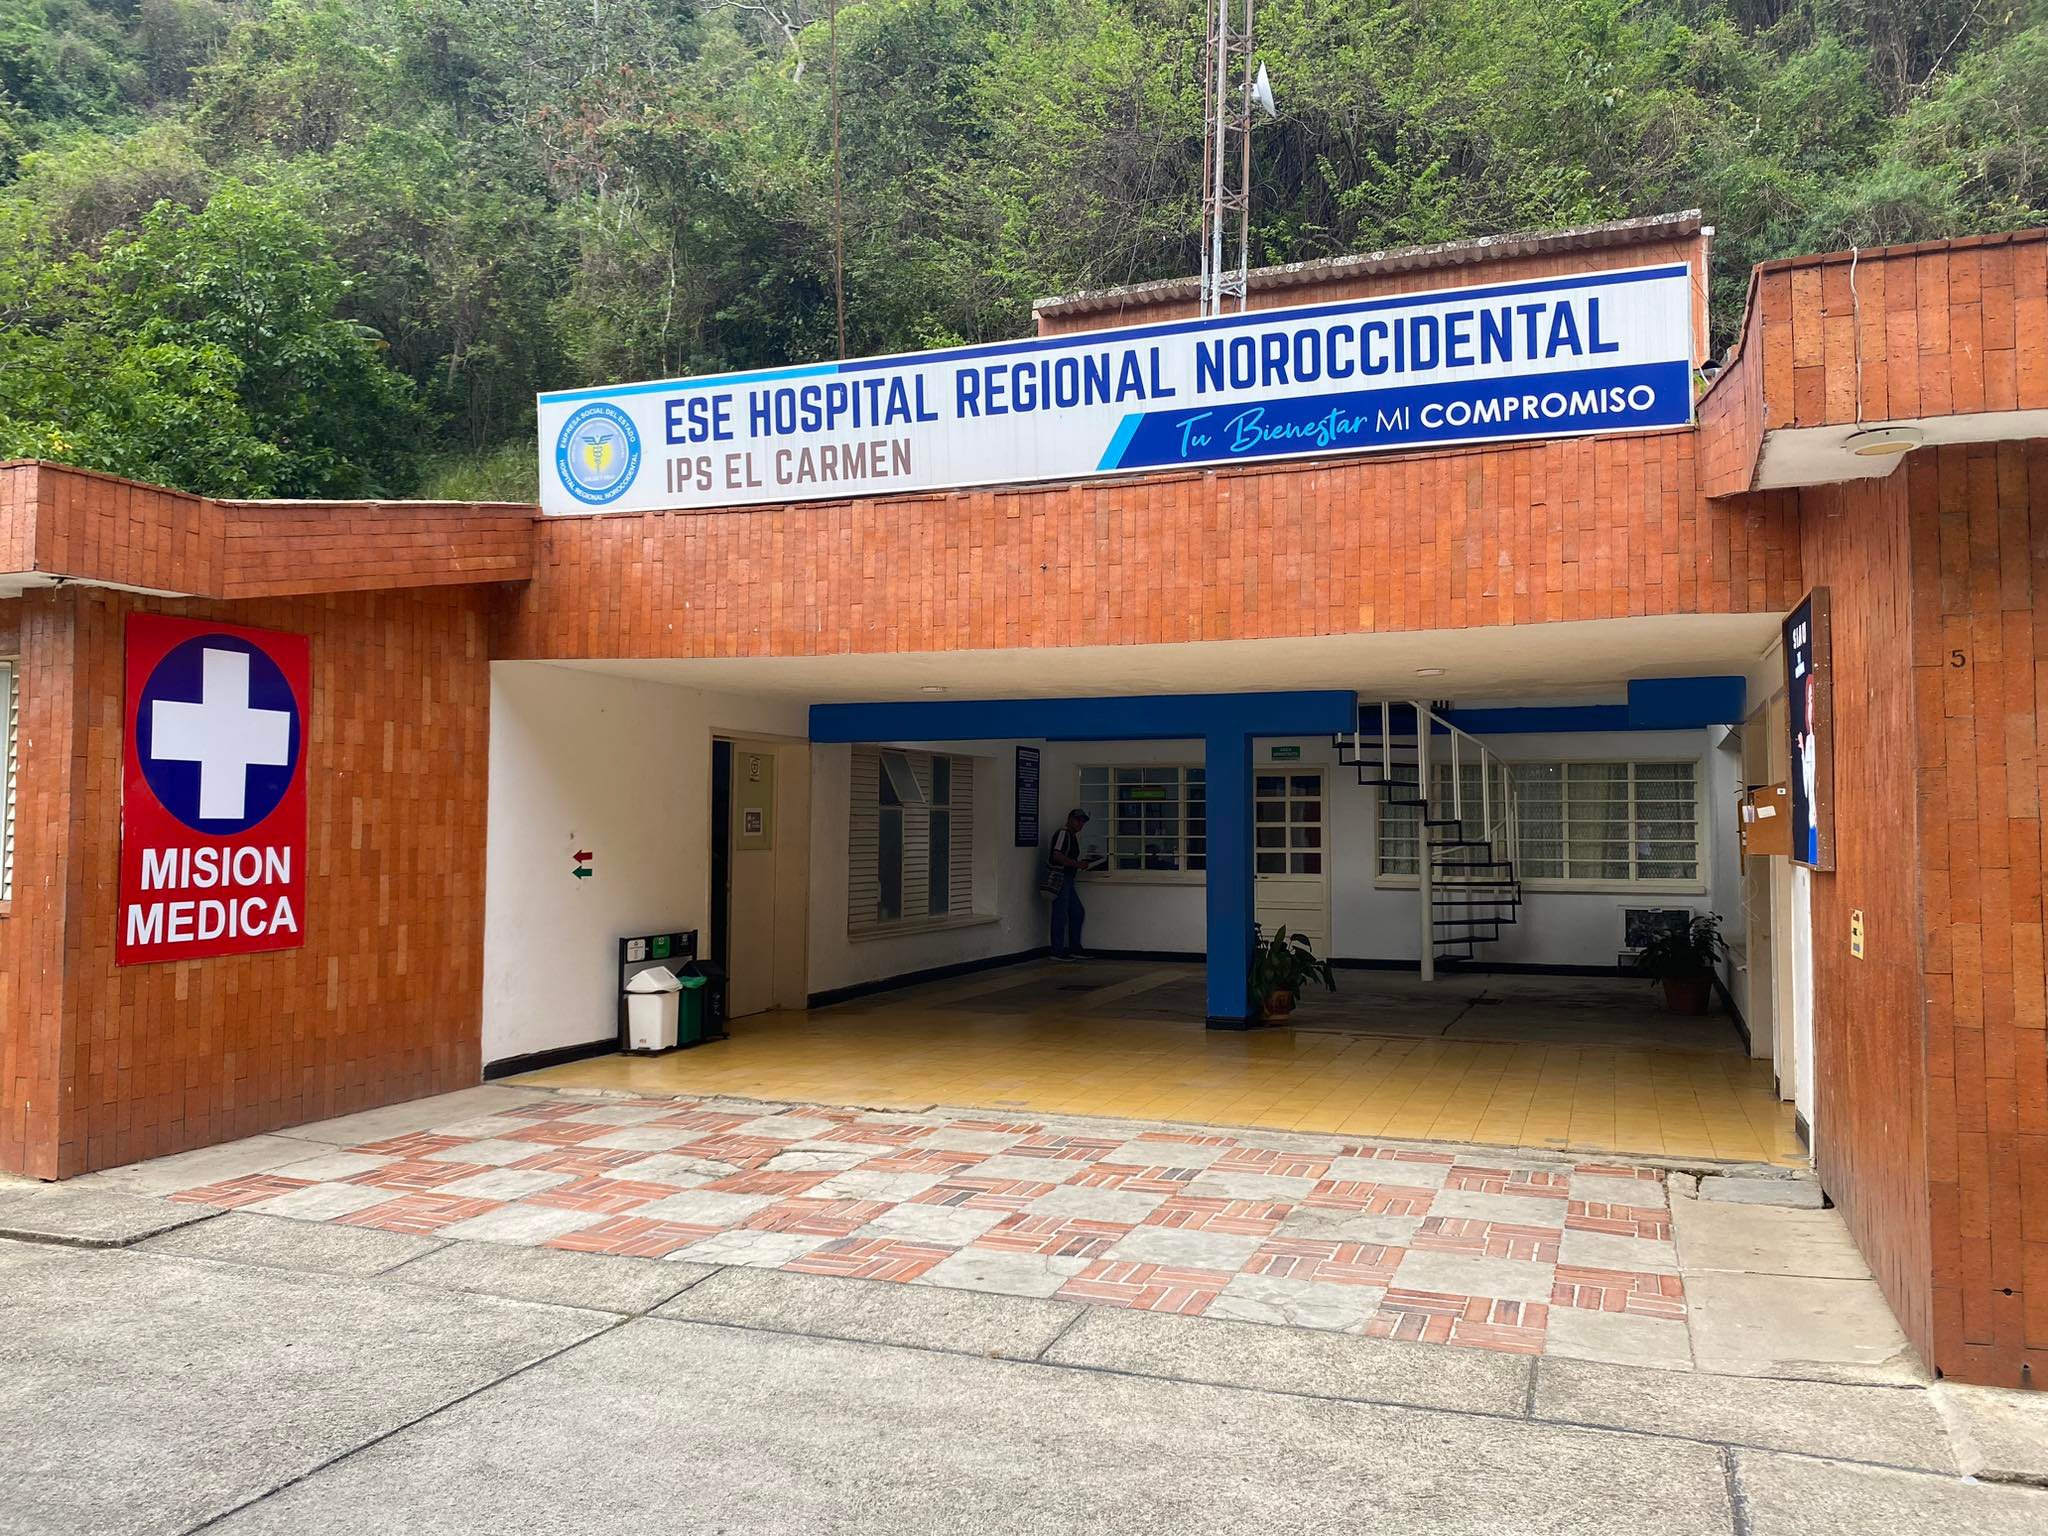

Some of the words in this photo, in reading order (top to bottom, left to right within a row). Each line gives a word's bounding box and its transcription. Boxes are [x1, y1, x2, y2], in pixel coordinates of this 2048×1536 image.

[665, 394, 734, 445] ESE
[749, 374, 939, 438] HOSPITAL
[956, 347, 1176, 418] REGIONAL
[1195, 297, 1619, 393] NOROCCIDENTAL
[560, 417, 582, 448] EMPRESA
[580, 407, 604, 418] SOCIAL
[605, 408, 618, 418] DEL
[617, 415, 636, 443] ESTADO
[1175, 411, 1213, 458] Tu
[1224, 407, 1368, 452] Bienestar
[1375, 406, 1410, 432] MI
[1420, 384, 1656, 428] COMPROMISO
[560, 459, 575, 490] HOSPITAL
[574, 487, 604, 501] REGIONAL
[604, 452, 639, 499] NOROCCIDENTAL
[666, 455, 712, 493] IPS
[725, 452, 762, 489] EL
[775, 438, 912, 485] CARMEN
[1950, 649, 1966, 668] 5
[140, 846, 291, 890] MISION
[126, 896, 298, 946] MEDICA
